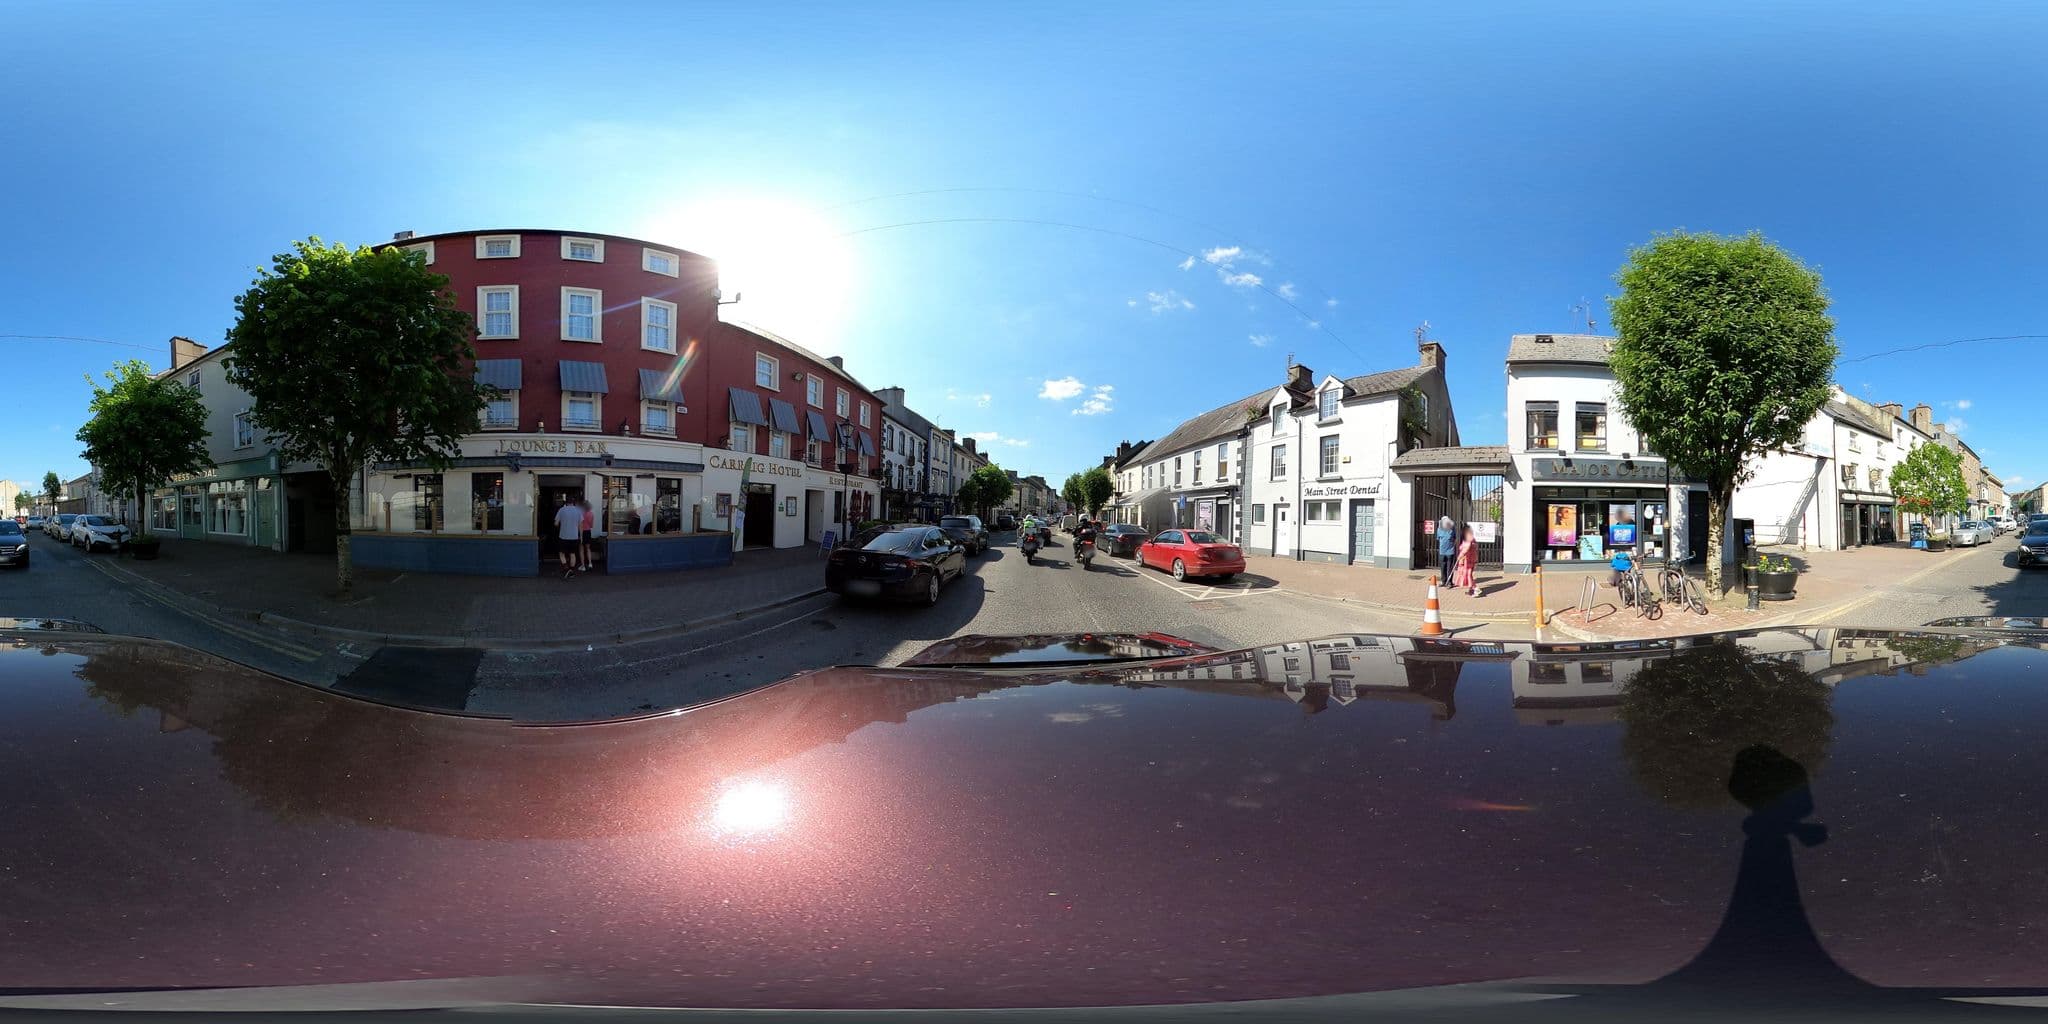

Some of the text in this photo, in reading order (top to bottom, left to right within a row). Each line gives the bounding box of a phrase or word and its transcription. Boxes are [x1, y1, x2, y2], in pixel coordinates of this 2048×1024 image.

[499, 439, 609, 454] LOUNGE BAR
[768, 462, 802, 478] HOTEL
[1551, 460, 1611, 478] MAJOR
[829, 476, 865, 489] RESTURANT
[1304, 482, 1382, 497] Main Street Dental
